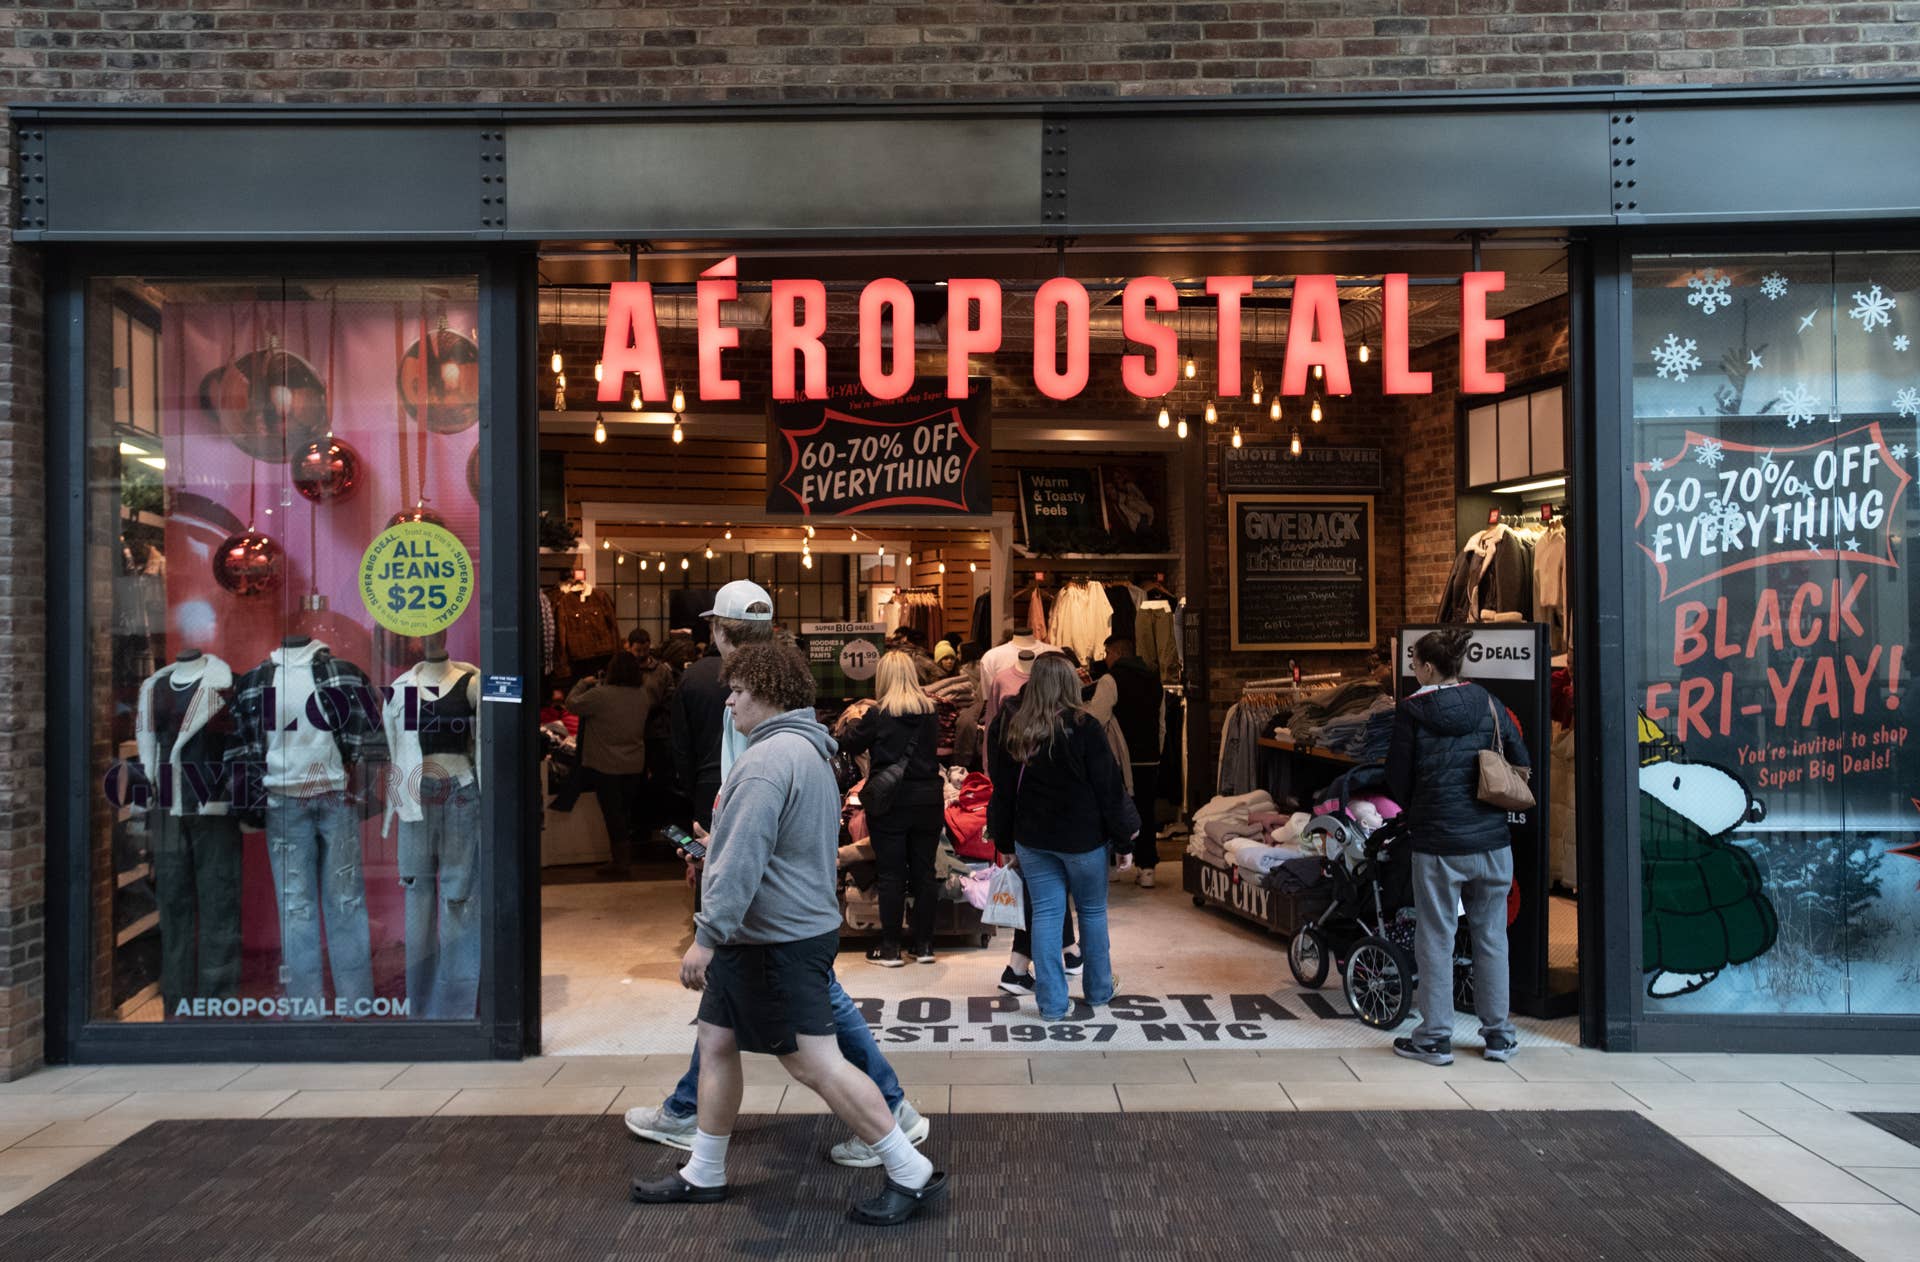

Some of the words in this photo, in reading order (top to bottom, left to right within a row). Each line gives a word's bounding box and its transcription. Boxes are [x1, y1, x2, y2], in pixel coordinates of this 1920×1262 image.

[597, 255, 1505, 401] AÉROPOSTALE
[801, 432, 904, 470] 60-70%
[913, 422, 960, 455] OFF
[801, 455, 961, 504] EVERYTHING
[1031, 475, 1069, 488] Warm
[1653, 460, 1799, 516] 60-70%
[1813, 443, 1881, 490] OFF
[1033, 490, 1042, 502] &
[1044, 490, 1086, 504] Toasty
[1034, 504, 1068, 516] Feels
[1654, 489, 1885, 563] EVERYTHING
[366, 554, 377, 571] BIG
[393, 540, 439, 558] ALL
[377, 561, 455, 580] JEANS
[454, 551, 468, 584] SUPER
[387, 583, 447, 613] $25
[456, 586, 468, 603] BIG
[835, 623, 854, 632] BIG
[1674, 573, 1868, 666] BLACK
[1486, 646, 1531, 660] DEALS
[1646, 644, 1903, 742] FRI-YAY!
[1737, 742, 1786, 766] You're
[1793, 731, 1846, 756] invited
[1851, 731, 1866, 749] to
[1873, 724, 1908, 747] shop
[1758, 767, 1803, 790] Super
[1809, 760, 1835, 782] Big
[1843, 749, 1891, 774] Deals!
[1201, 866, 1230, 902] CAP
[1232, 882, 1271, 920] CITY
[174, 997, 411, 1017] AEROPOSTALE.COM
[982, 1024, 1118, 1043] 1987
[1140, 1023, 1268, 1042] NYC
